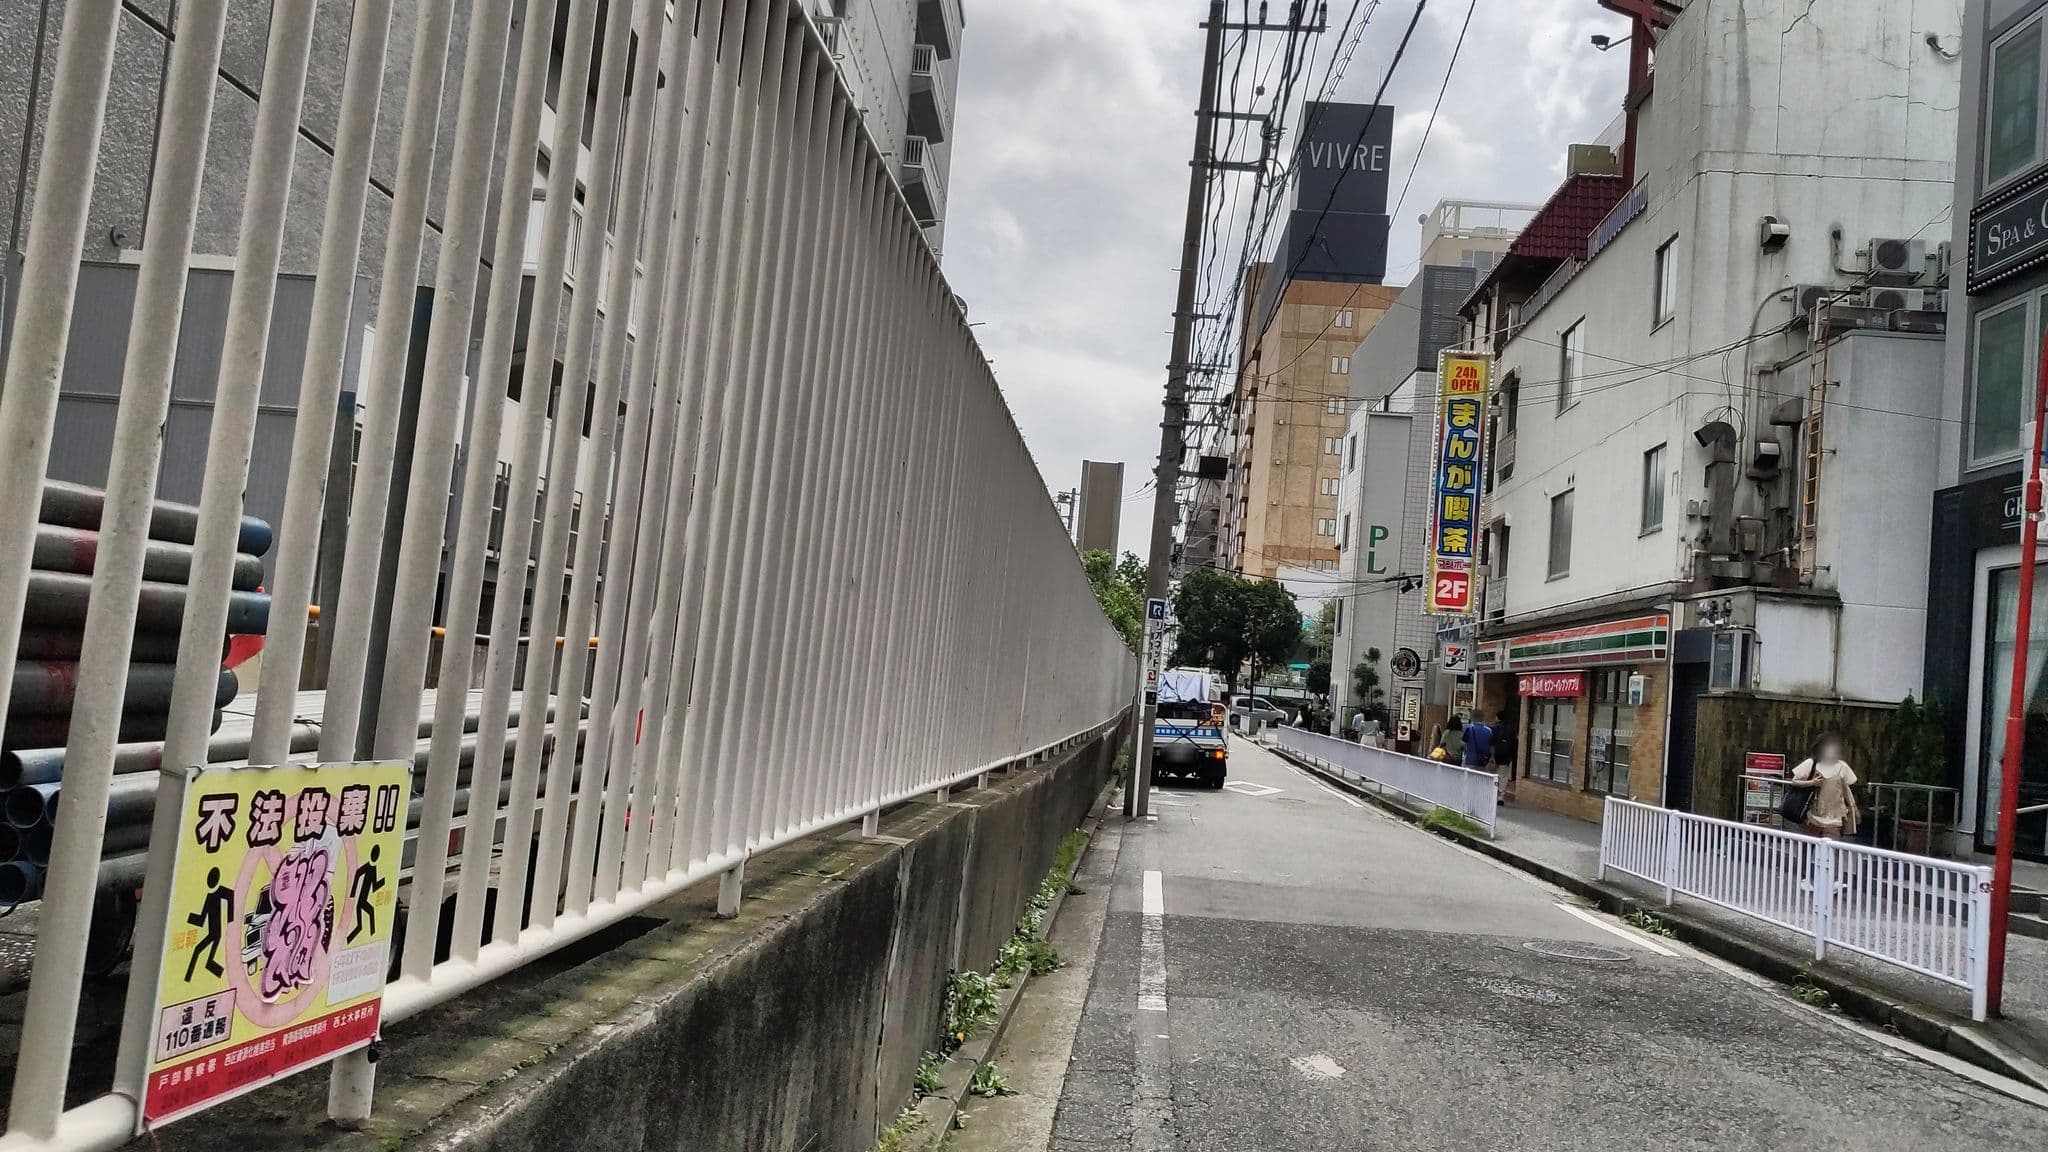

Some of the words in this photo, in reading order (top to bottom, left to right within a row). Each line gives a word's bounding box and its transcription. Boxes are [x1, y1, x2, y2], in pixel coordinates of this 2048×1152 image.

[1309, 141, 1385, 172] VIVRE
[2023, 218, 2036, 239] &
[1455, 365, 1478, 380] 24h
[1451, 379, 1480, 392] OPEN
[1441, 401, 1477, 553] まんが喫茶
[1437, 579, 1467, 599] 2F
[165, 1017, 227, 1051] 110番通報
